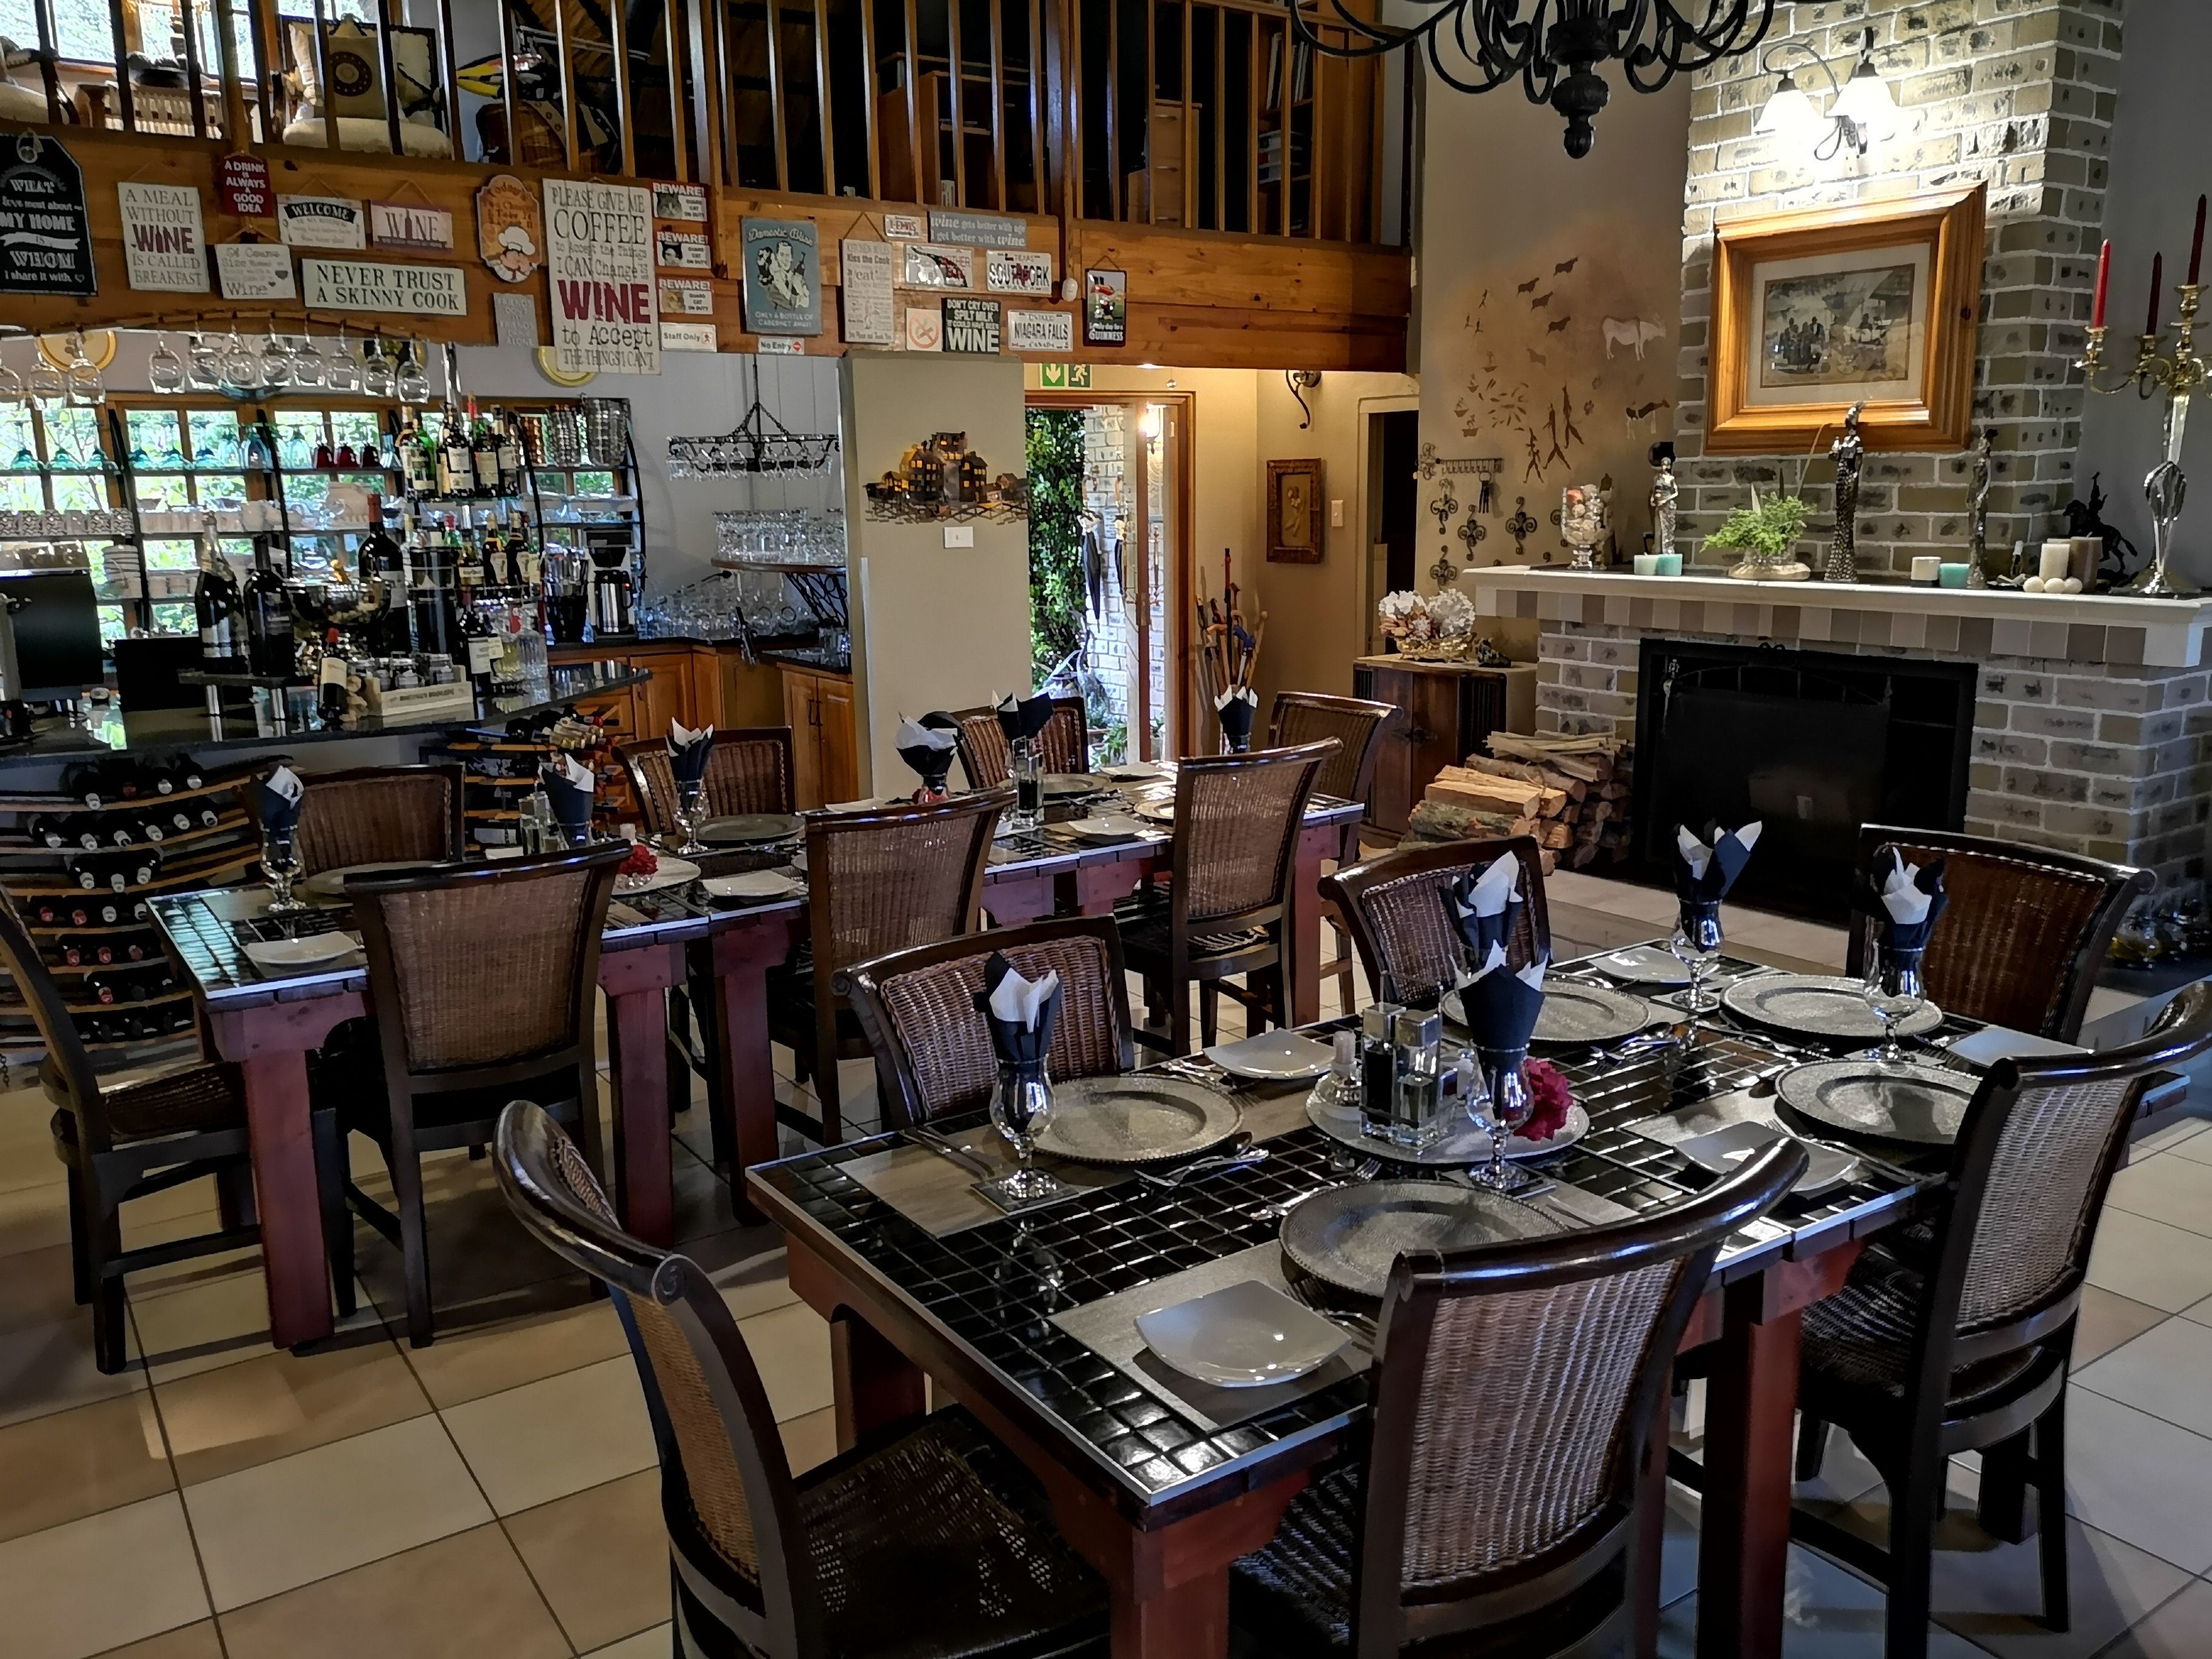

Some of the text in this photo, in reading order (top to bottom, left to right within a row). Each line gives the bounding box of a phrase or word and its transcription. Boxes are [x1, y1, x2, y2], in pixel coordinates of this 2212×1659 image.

[224, 160, 266, 173] A DRINK
[10, 179, 55, 193] WHAT
[226, 176, 266, 189] ALWAYS
[653, 183, 704, 196] BEWARE!
[126, 189, 193, 207] A MEAL
[233, 193, 264, 204] GOOD
[552, 186, 645, 213] PLEASE GIVE ME
[126, 206, 195, 224] WITHOUT
[237, 203, 263, 213] IDEA
[291, 203, 350, 220] WELCOME
[0, 212, 76, 231] MY HOME
[386, 209, 438, 241] WINE
[554, 209, 646, 245] COFFEE
[930, 214, 959, 229] wine
[961, 220, 976, 230] gets
[977, 220, 997, 230] better
[998, 222, 1013, 232] with
[132, 224, 195, 255] WINE
[657, 232, 708, 244] BEWARE!
[748, 227, 813, 246] Domestic Bliss
[937, 232, 950, 241] get
[951, 231, 977, 243] better
[978, 234, 995, 244] with
[997, 233, 1026, 247] wine
[10, 251, 75, 269] WHOM
[133, 253, 201, 269] IS CALLED
[862, 255, 873, 264] the
[5, 270, 72, 282] I share it with
[556, 256, 563, 273] I
[565, 255, 592, 277] CAN
[595, 259, 637, 282] Change
[134, 269, 201, 286] BREAKFAST
[317, 264, 454, 291] NEVER TRUST
[659, 279, 710, 290] BEWARE!
[226, 282, 268, 296] Wine
[317, 286, 459, 311] A SKINNY COOK
[557, 280, 651, 324] WINE
[968, 300, 980, 310] CRY
[982, 301, 999, 312] OVER
[954, 309, 993, 322] SPILT MILK
[561, 325, 653, 350] to Accept
[683, 333, 700, 342] Only
[947, 327, 999, 352] WINE
[1015, 322, 1068, 340] NIAGARA FALLS
[773, 341, 791, 351] Entry
[563, 349, 582, 366] THE
[585, 349, 620, 366] THINGS
